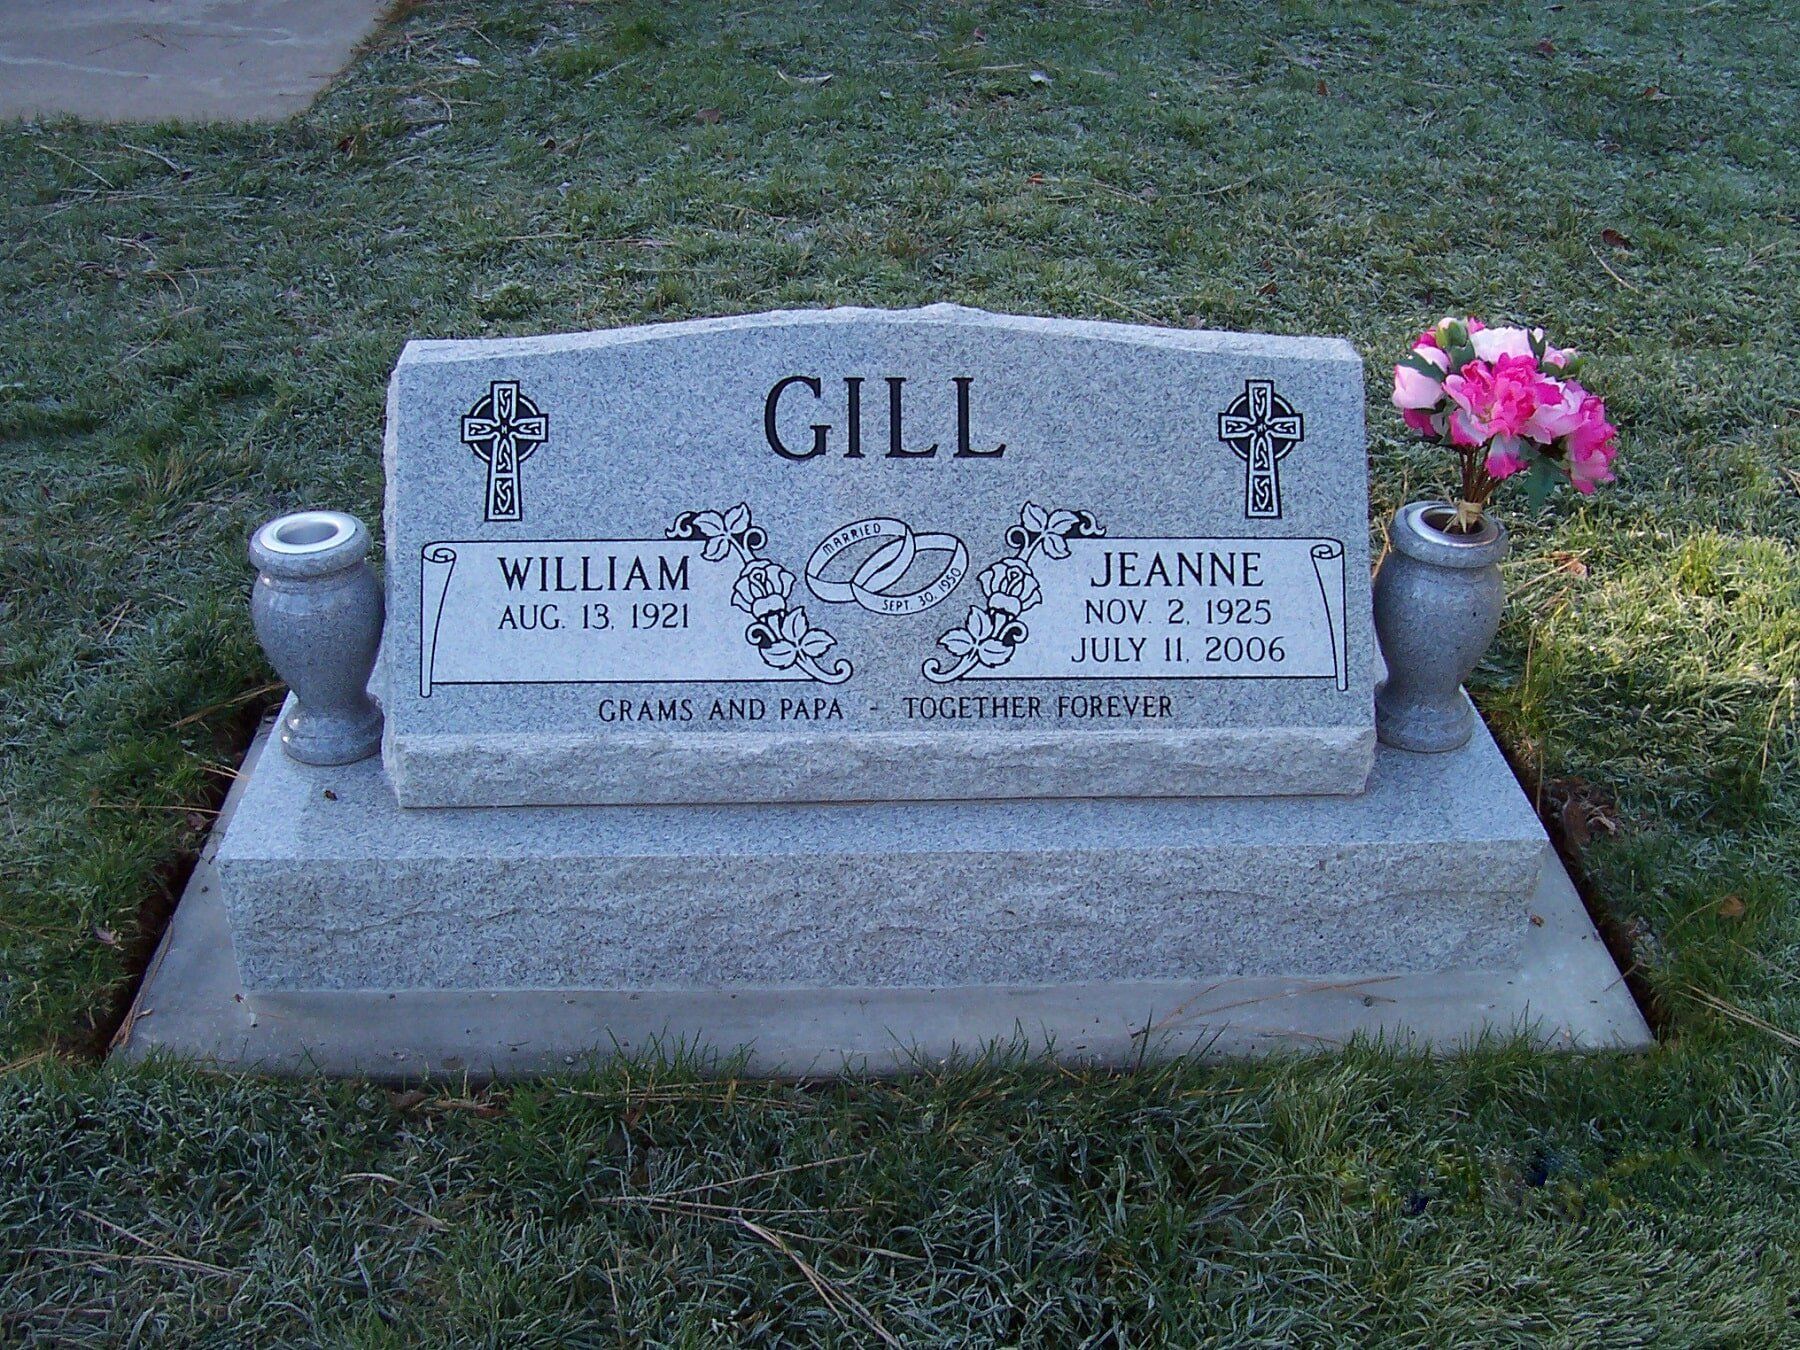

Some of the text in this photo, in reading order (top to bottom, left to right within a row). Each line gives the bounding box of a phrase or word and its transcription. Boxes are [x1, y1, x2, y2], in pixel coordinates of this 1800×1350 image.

[764, 375, 1007, 461] GILL
[822, 523, 881, 556] MARRIED
[497, 555, 690, 591] WILLIAM
[939, 567, 962, 592] 1950
[1090, 551, 1264, 587] JEANNE
[498, 603, 689, 630] AUG. 13, 1921
[1085, 599, 1271, 625] NOV. 2, 1925
[1071, 636, 1285, 663] JULY 11, 2006
[599, 699, 693, 722] GRAMS
[708, 699, 766, 721] AND
[780, 698, 844, 720] PAPA
[902, 696, 1042, 719] TOGETHER
[1058, 695, 1173, 718] FOREVER
